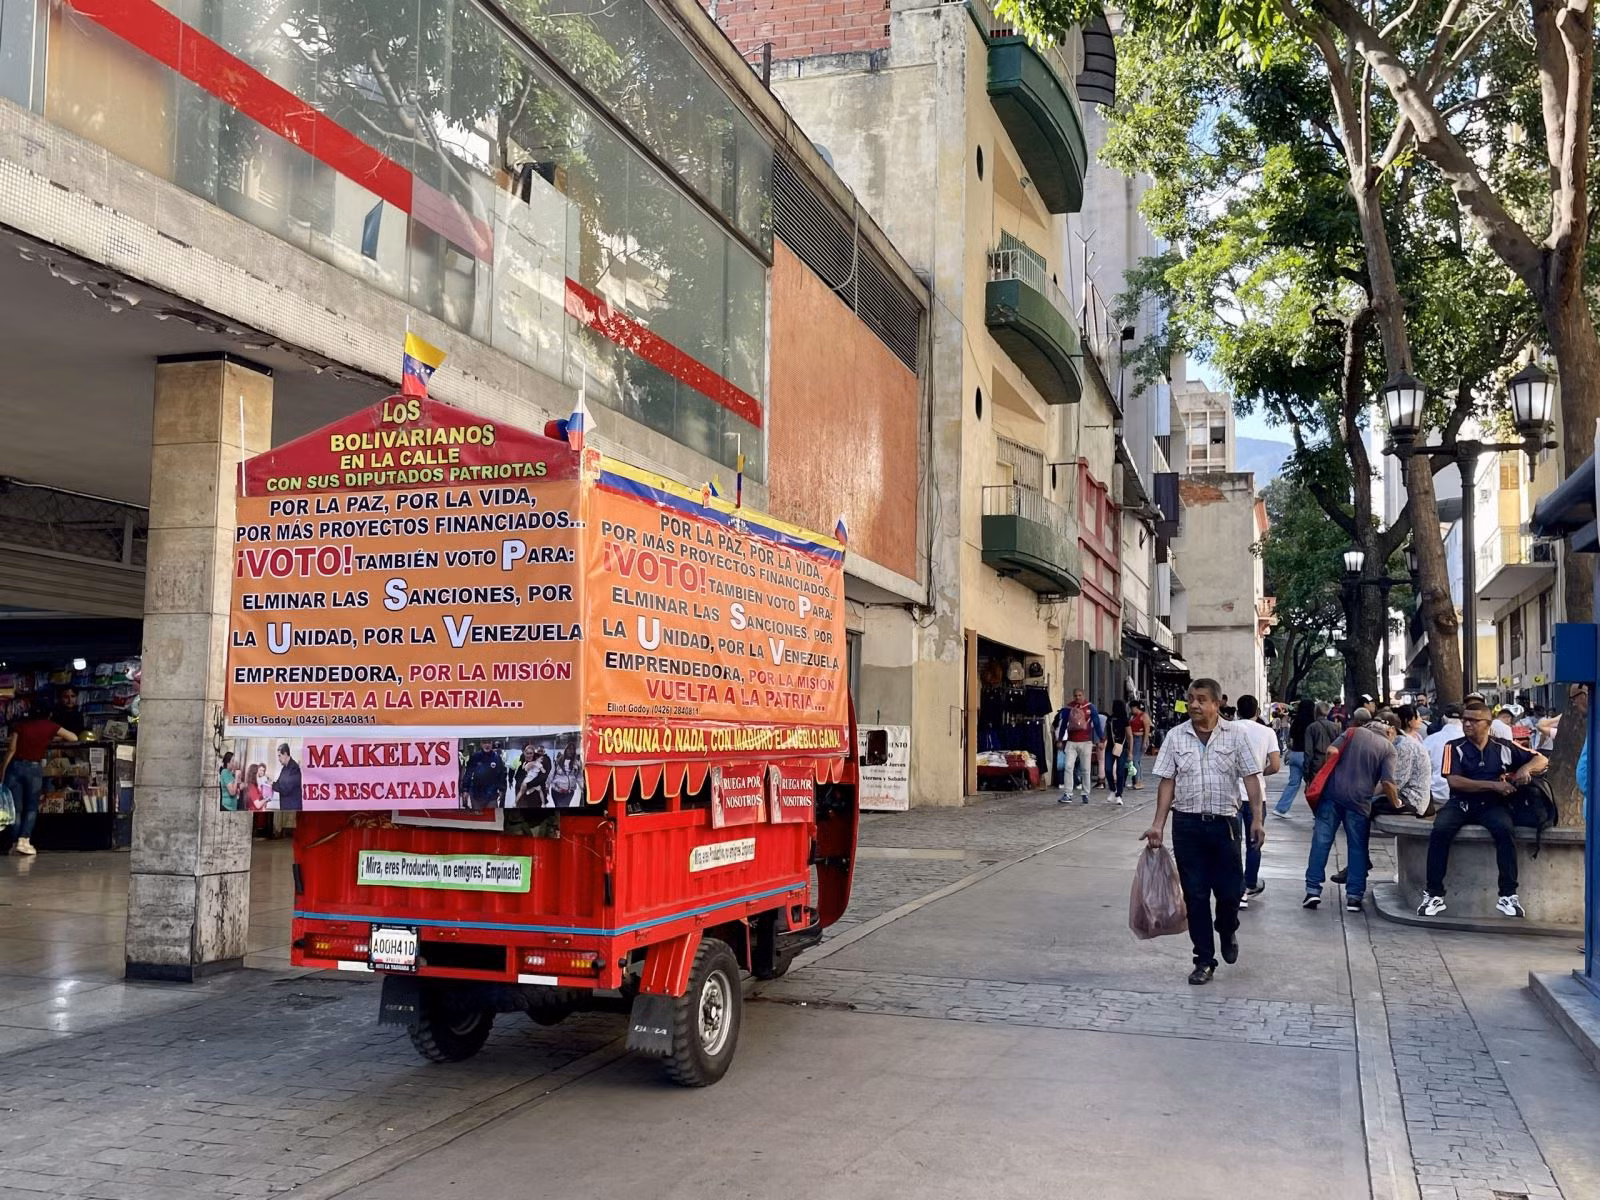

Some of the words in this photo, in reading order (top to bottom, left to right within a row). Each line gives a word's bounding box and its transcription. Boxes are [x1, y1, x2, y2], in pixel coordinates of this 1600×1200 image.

[382, 400, 421, 424] LOS
[330, 425, 496, 452] BOLIVARIANOS
[340, 455, 367, 470] EN
[371, 453, 394, 468] LA
[399, 449, 460, 467] CALLE
[266, 478, 302, 492] CON
[306, 474, 340, 489] SUS
[345, 469, 444, 488] DIPUTADOS
[450, 462, 547, 482] PATRIOTAS
[270, 499, 309, 517] POR
[315, 497, 340, 514] LA
[346, 495, 390, 515] PAZ,
[396, 492, 438, 511] POR
[445, 490, 472, 509] LA
[479, 487, 537, 508] VIDA,
[236, 525, 271, 542] POR
[276, 520, 314, 540] MÁS
[319, 518, 429, 538] PROYECTOS
[435, 511, 586, 533] FINANCIADOS...
[237, 545, 353, 578] ¡VOTO!
[356, 548, 439, 571] TAMBIÉN
[445, 549, 497, 568] VOTO
[501, 539, 575, 571] PARA:
[602, 520, 637, 544] POR
[643, 530, 675, 554] MÁS
[680, 543, 756, 577] PROYECTOS
[661, 514, 692, 540] POR
[696, 525, 714, 547] LA
[719, 533, 746, 561] PAZ,
[750, 543, 774, 566] POR
[778, 550, 793, 571] LA
[795, 559, 823, 583] VIDA,
[243, 592, 326, 610] ELMINAR
[332, 591, 369, 608] LAS
[383, 578, 521, 612] SANCIONES,
[528, 584, 573, 602] POR
[604, 542, 706, 595] ¡VOTO!
[766, 592, 796, 613] VOTO
[798, 595, 833, 622] PARA:
[612, 586, 688, 616] ELMINAR
[693, 603, 720, 622] LAS
[814, 629, 833, 644] POR
[233, 630, 257, 648] LA
[267, 622, 357, 654] UNIDAD,
[363, 628, 403, 645] POR
[410, 627, 436, 644] LA
[442, 615, 584, 648] VENEZUELA
[603, 618, 627, 638] LA
[637, 614, 714, 655] UNIDAD,
[718, 637, 745, 656] POR
[749, 642, 764, 659] LA
[769, 637, 839, 670] VENEZUELA
[234, 666, 402, 685] EMPRENDEDORA,
[409, 664, 451, 682] POR
[458, 663, 486, 681] LA
[493, 659, 572, 681] MISIÓN
[605, 651, 745, 684] EMPRENDEDORA,
[749, 669, 774, 686] POR
[778, 671, 794, 687] LA
[275, 691, 357, 709] VUELTA
[363, 691, 378, 709] A
[385, 690, 414, 709] LA
[420, 690, 523, 709] PATRIA...
[608, 703, 626, 712] Elliot
[628, 704, 650, 715] Godoy
[652, 705, 672, 715] (0426)
[674, 705, 699, 716] 2840811
[646, 679, 717, 703] VUELTA
[724, 685, 735, 704] A
[741, 688, 759, 707] LA
[765, 690, 825, 712] PATRIA...
[232, 716, 259, 724] Elliot
[261, 716, 292, 727] Godoy
[295, 715, 328, 726] (0426)
[331, 716, 376, 725] 2840811
[307, 742, 451, 768] MAIKELYS
[599, 727, 660, 755] ¡COMUNA
[663, 727, 671, 751] O
[675, 727, 708, 756] NADA,
[710, 729, 732, 751] CON
[734, 728, 773, 751] MADURO
[775, 729, 785, 750] EL
[787, 729, 817, 749] PUEBLO
[819, 729, 841, 748] GANA!
[334, 781, 457, 801] RESCATADA!
[723, 777, 745, 790] RUEGA
[747, 776, 761, 788] POR
[782, 779, 800, 790] RUEGA
[801, 779, 812, 790] POR
[726, 794, 763, 808] NOSOTROS
[783, 796, 812, 806] NOSOTROS
[366, 857, 382, 877] Mira,
[385, 864, 399, 875] eres
[401, 858, 440, 879] Productivo,
[443, 864, 452, 877] no
[453, 862, 484, 882] emigres,
